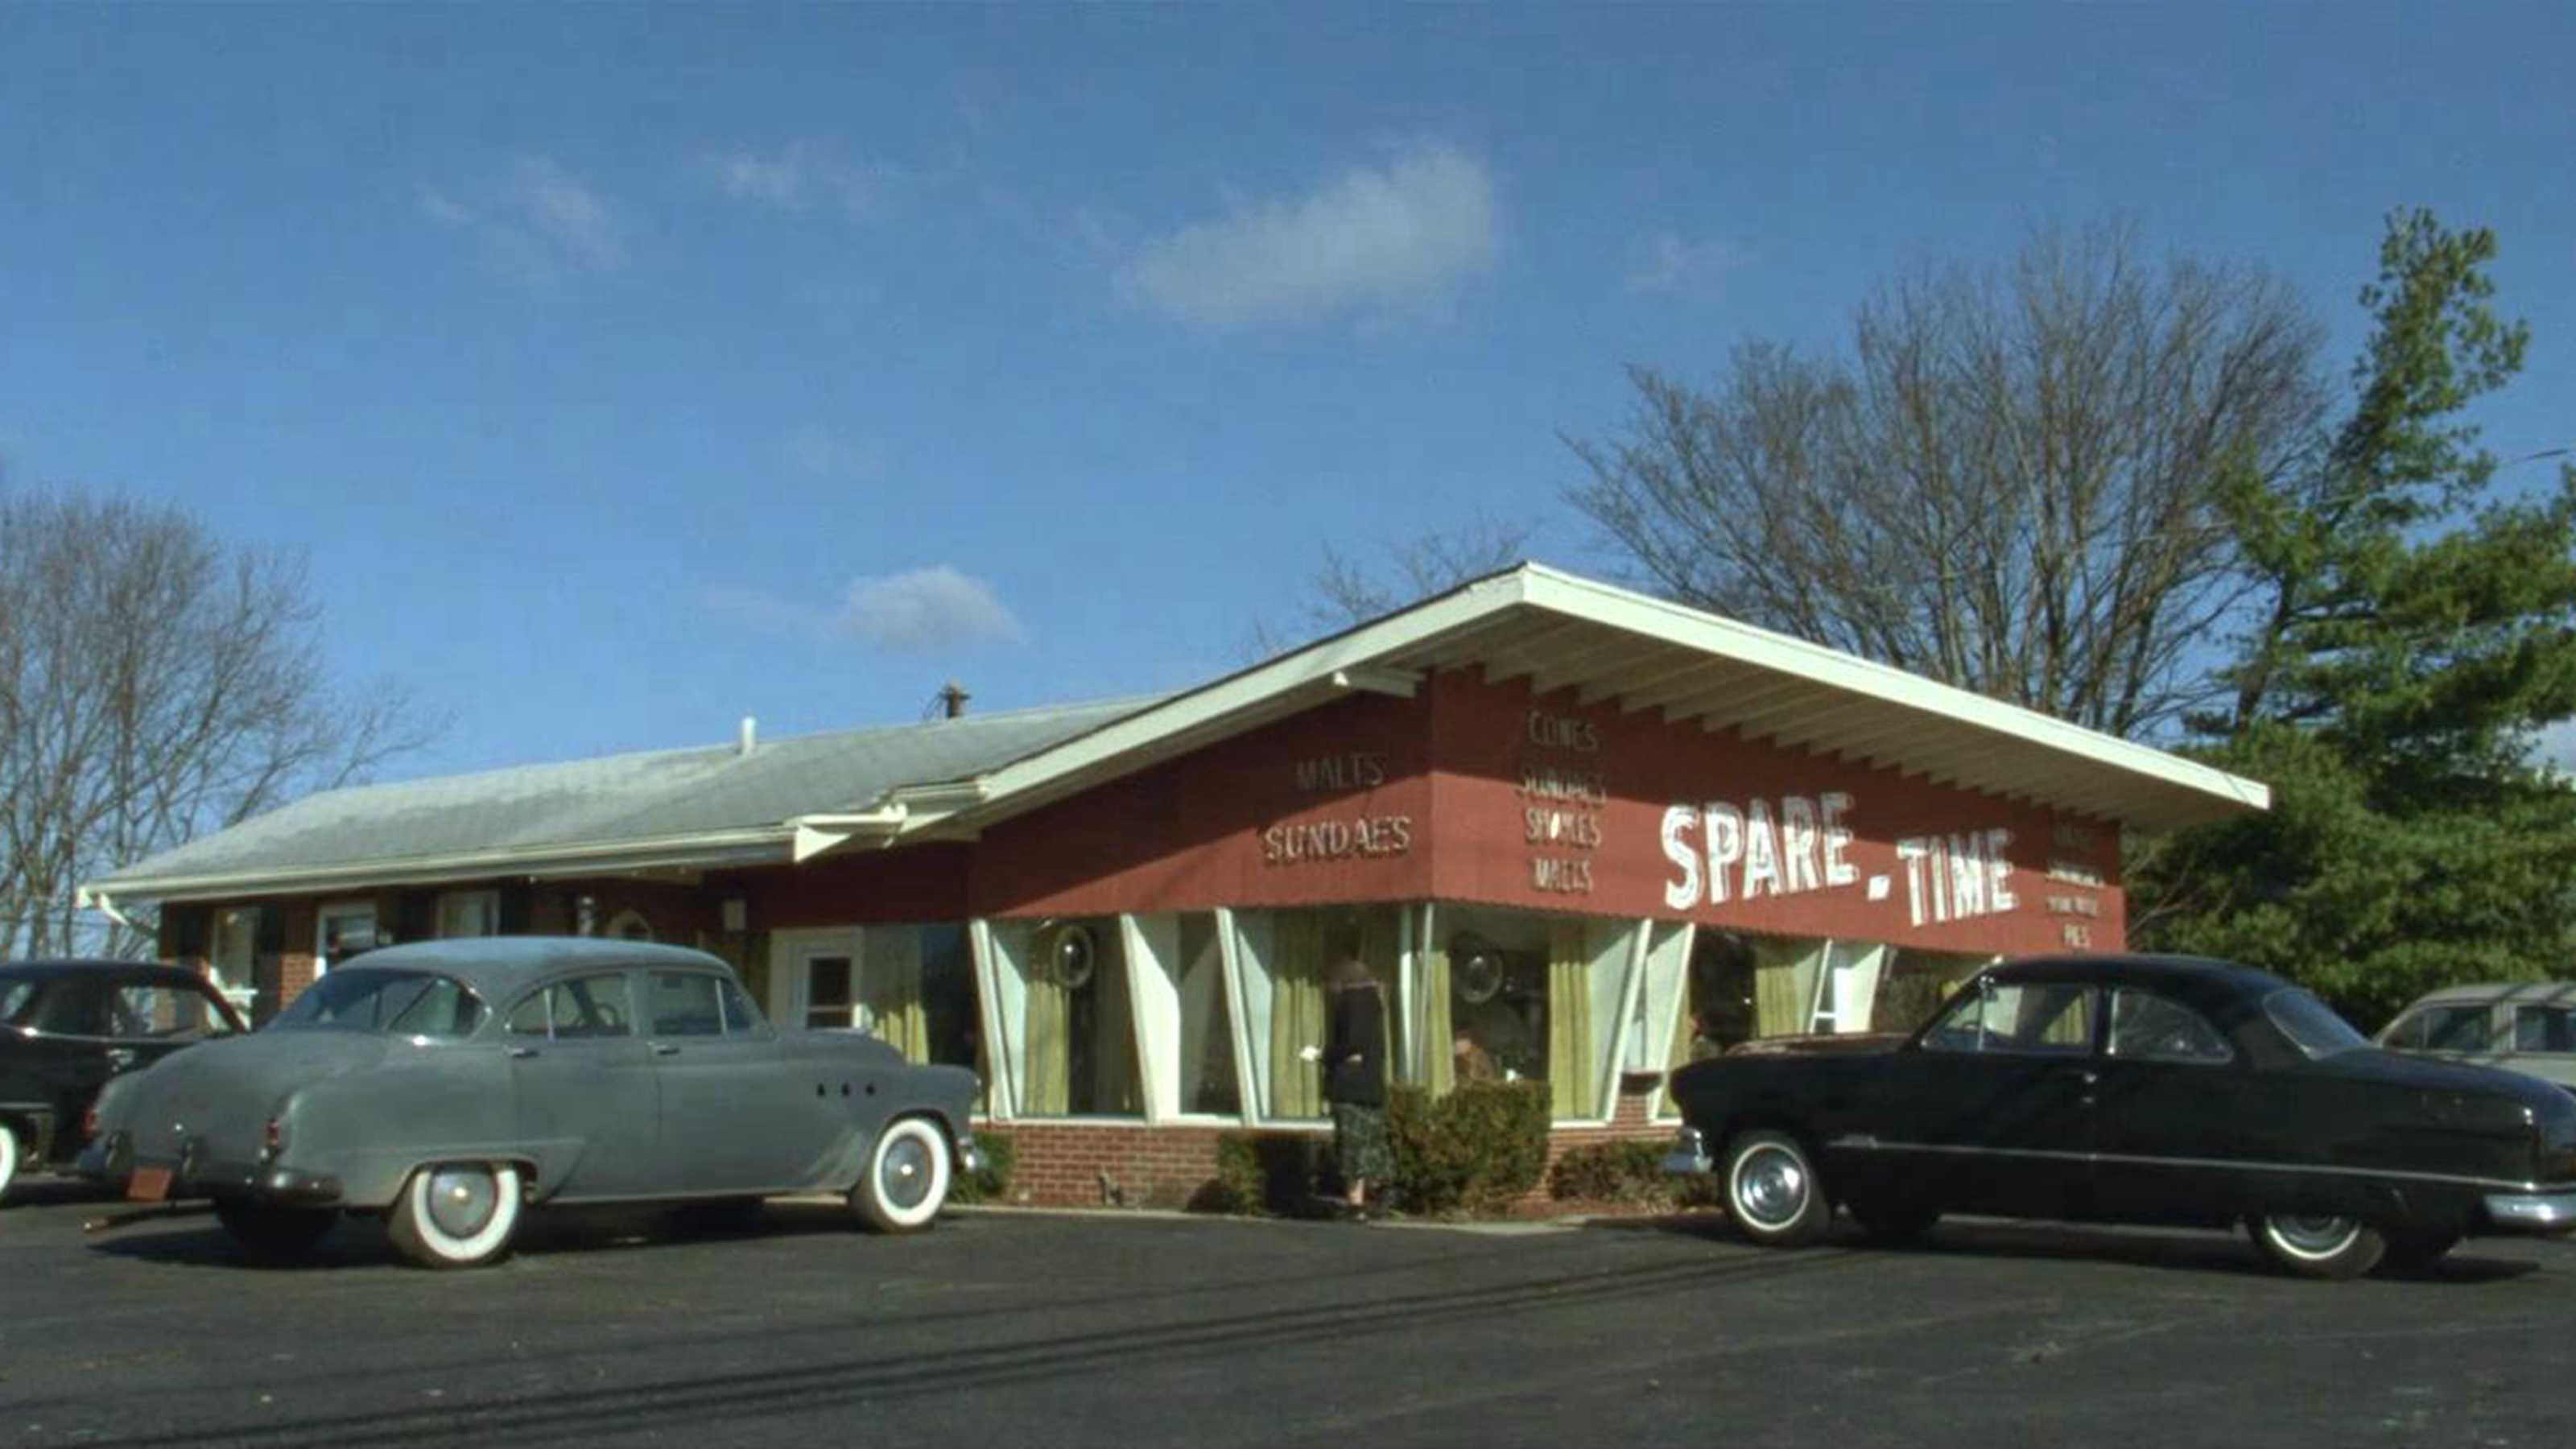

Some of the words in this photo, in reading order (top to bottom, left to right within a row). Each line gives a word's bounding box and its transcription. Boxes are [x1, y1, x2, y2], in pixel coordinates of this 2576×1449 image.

[1527, 709, 1599, 752] CONES
[1295, 752, 1386, 790] MALTS
[1264, 815, 1412, 861] SUNDAES
[1525, 807, 1602, 848] SHKES
[1534, 857, 1593, 893] MALTS
[1660, 791, 1860, 910] SPARE
[1897, 828, 2017, 927] TIME
